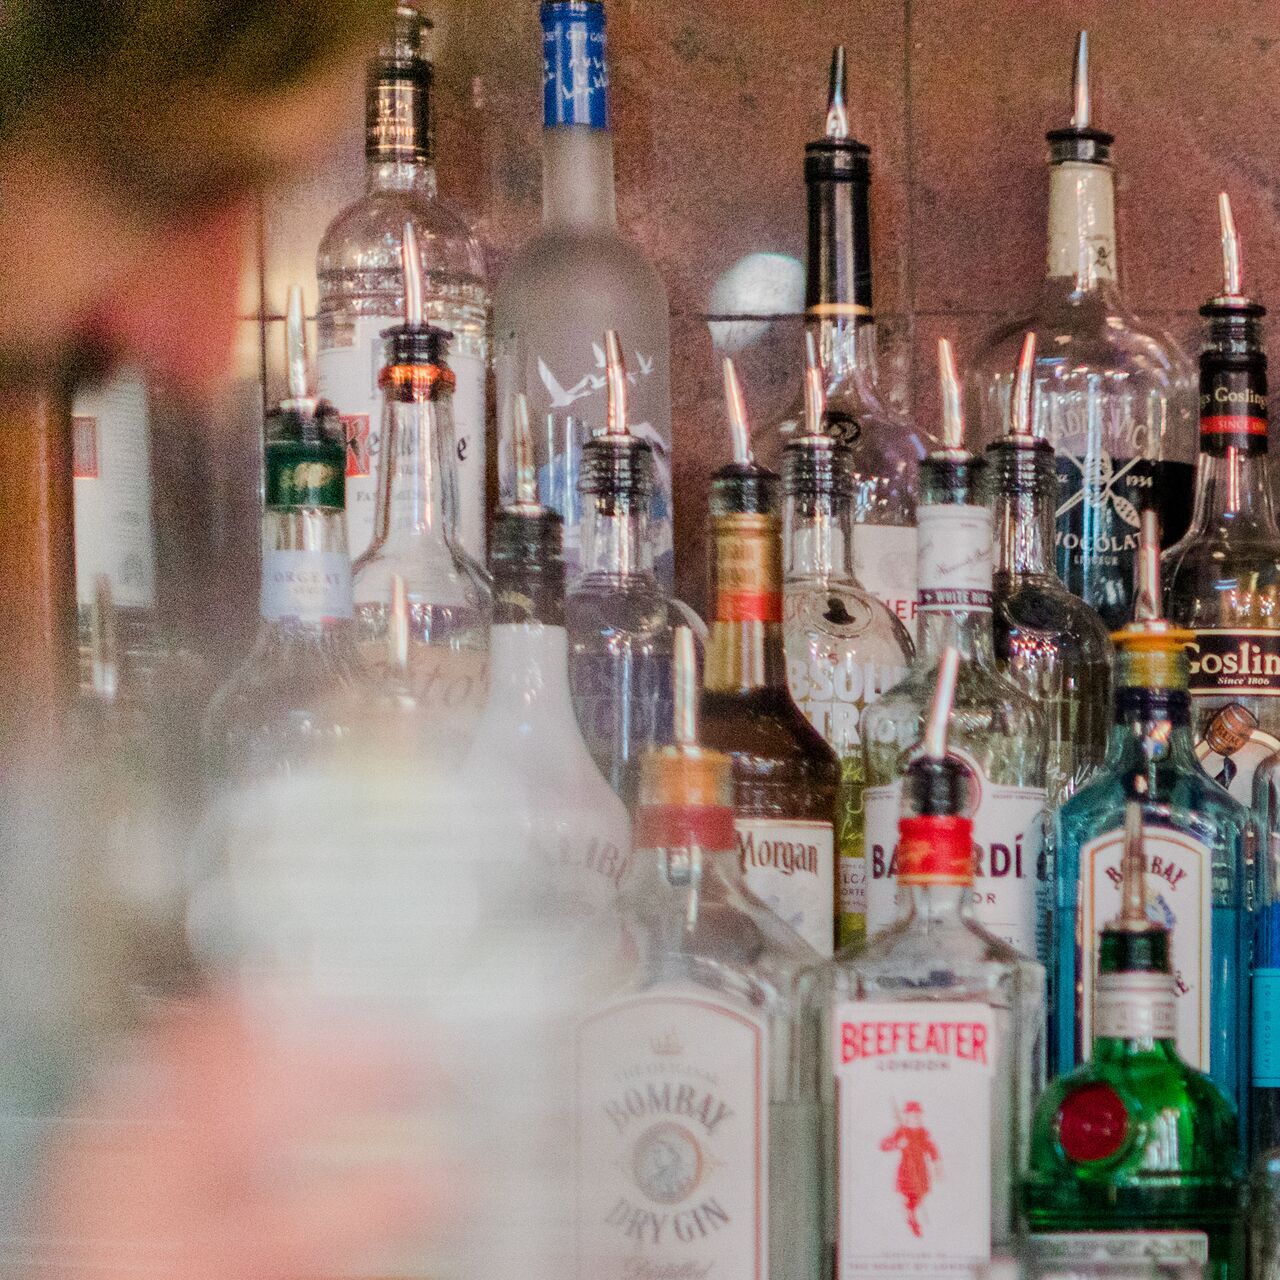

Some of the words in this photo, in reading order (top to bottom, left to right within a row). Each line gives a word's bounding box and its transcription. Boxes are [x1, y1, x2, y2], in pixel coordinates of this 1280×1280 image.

[1215, 386, 1268, 410] Gosling
[1217, 676, 1245, 685] Since
[1247, 676, 1270, 686] 1806
[840, 1020, 989, 1066] BEEFEATER
[605, 1079, 736, 1138] BOMBAY
[605, 1199, 664, 1246] DRY
[673, 1196, 731, 1245] GIN
